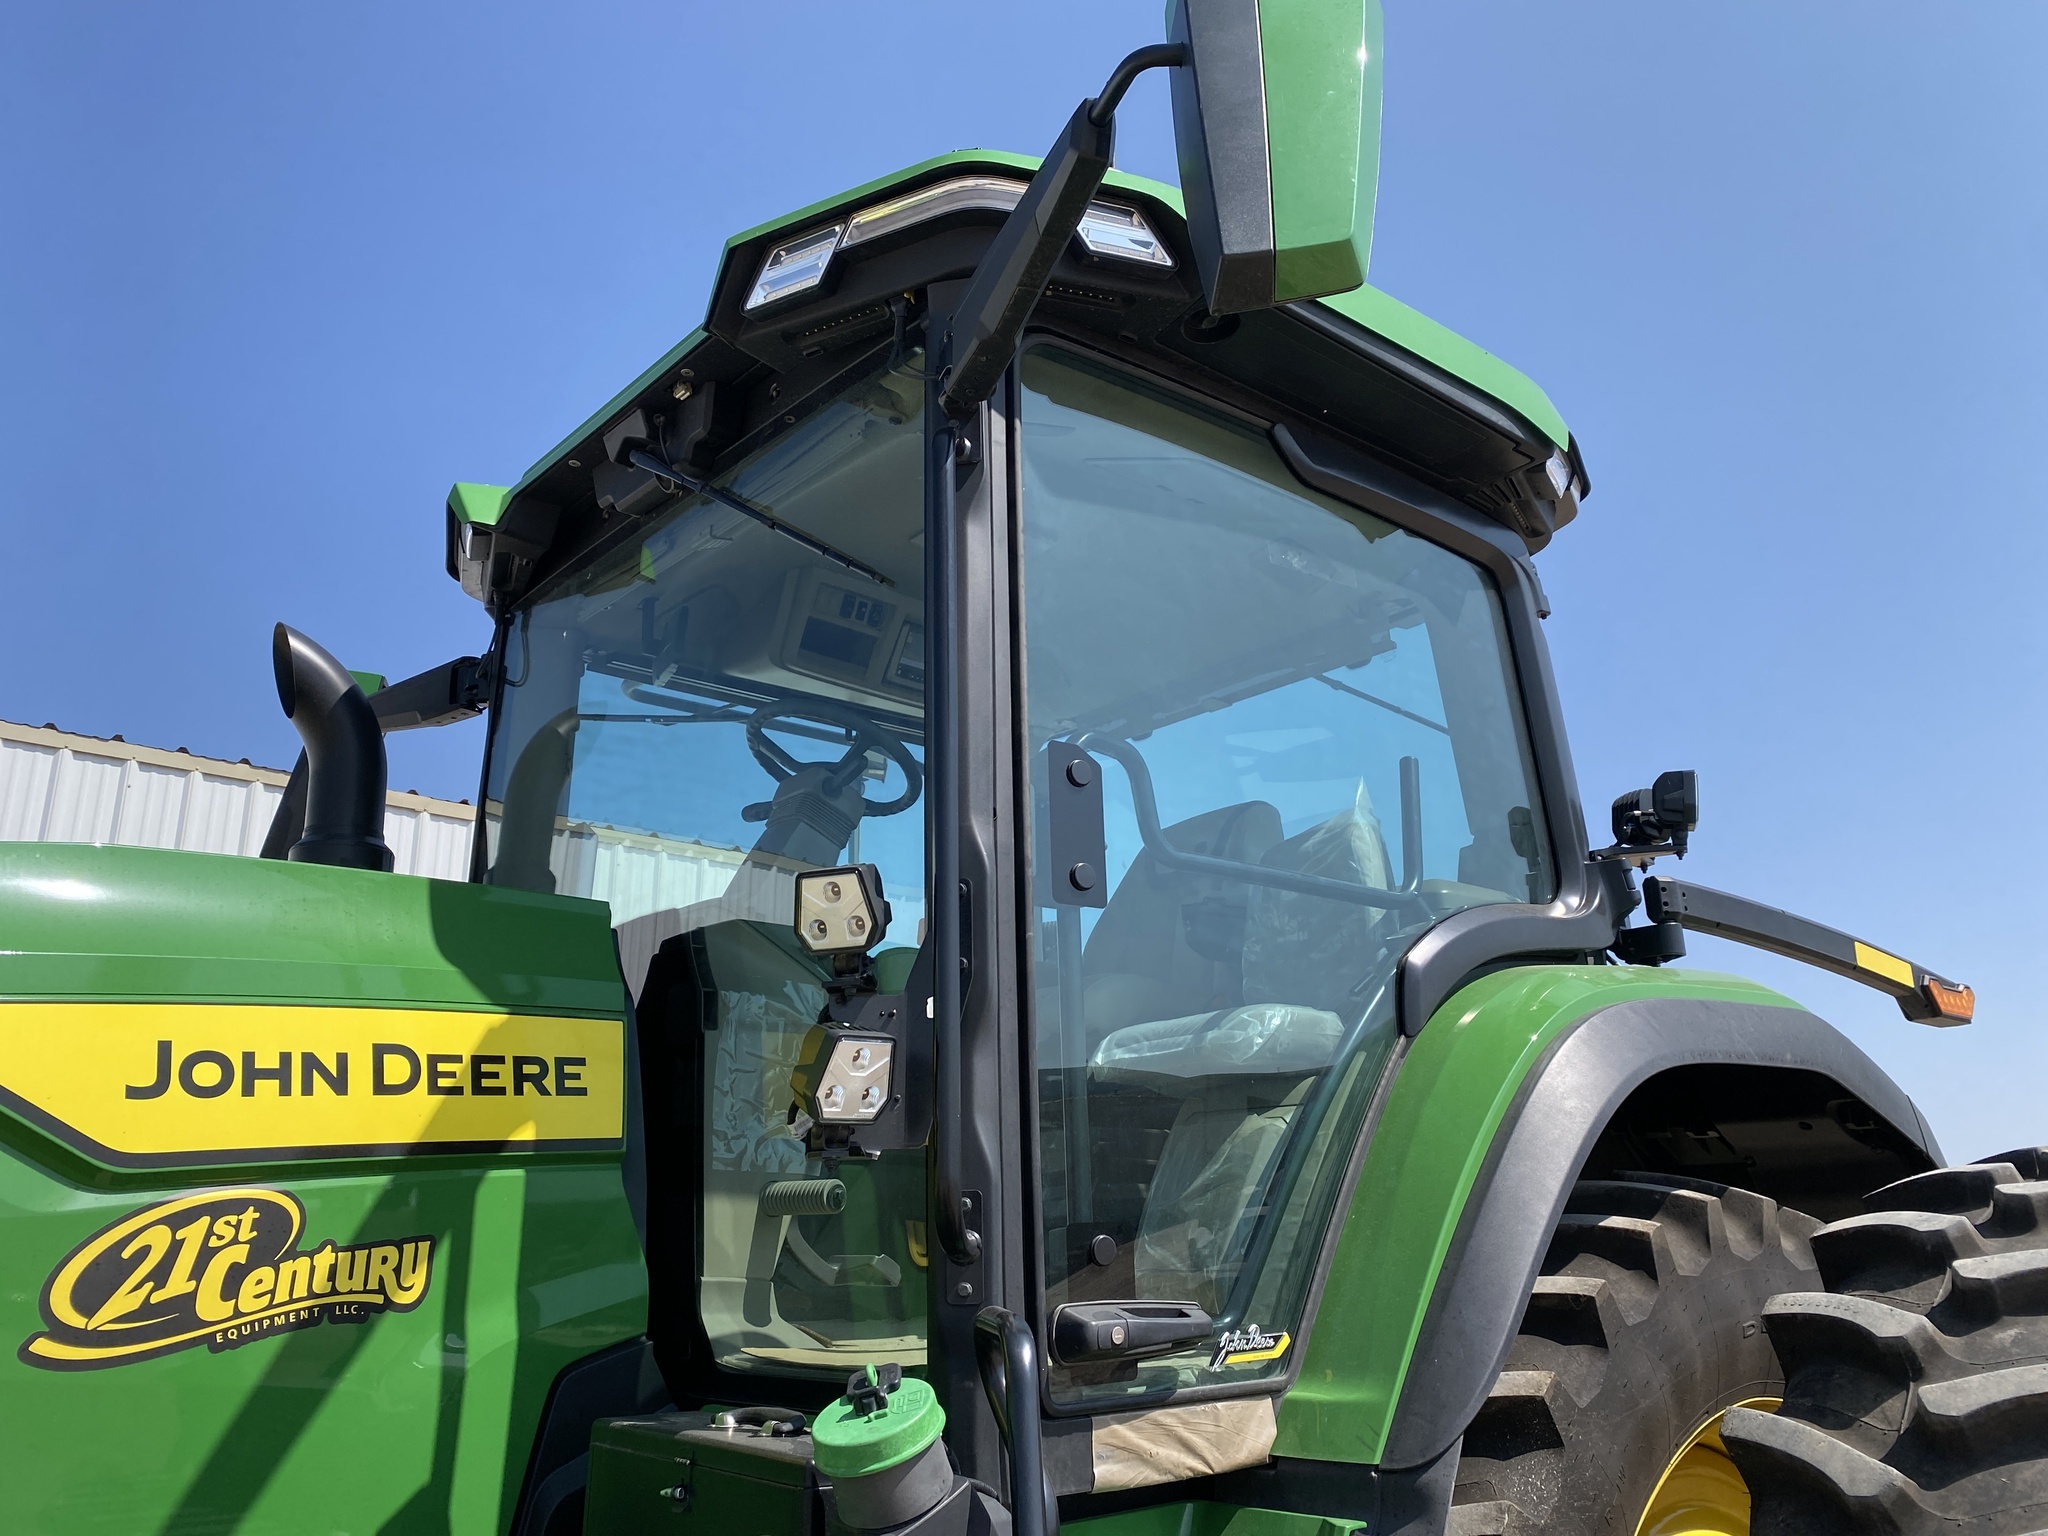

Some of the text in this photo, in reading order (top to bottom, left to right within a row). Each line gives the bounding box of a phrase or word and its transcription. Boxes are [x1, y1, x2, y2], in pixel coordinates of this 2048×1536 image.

[125, 1040, 588, 1100] JOHN DEERE
[87, 1206, 260, 1331] 21st
[215, 1307, 320, 1343] EQUIPMENT
